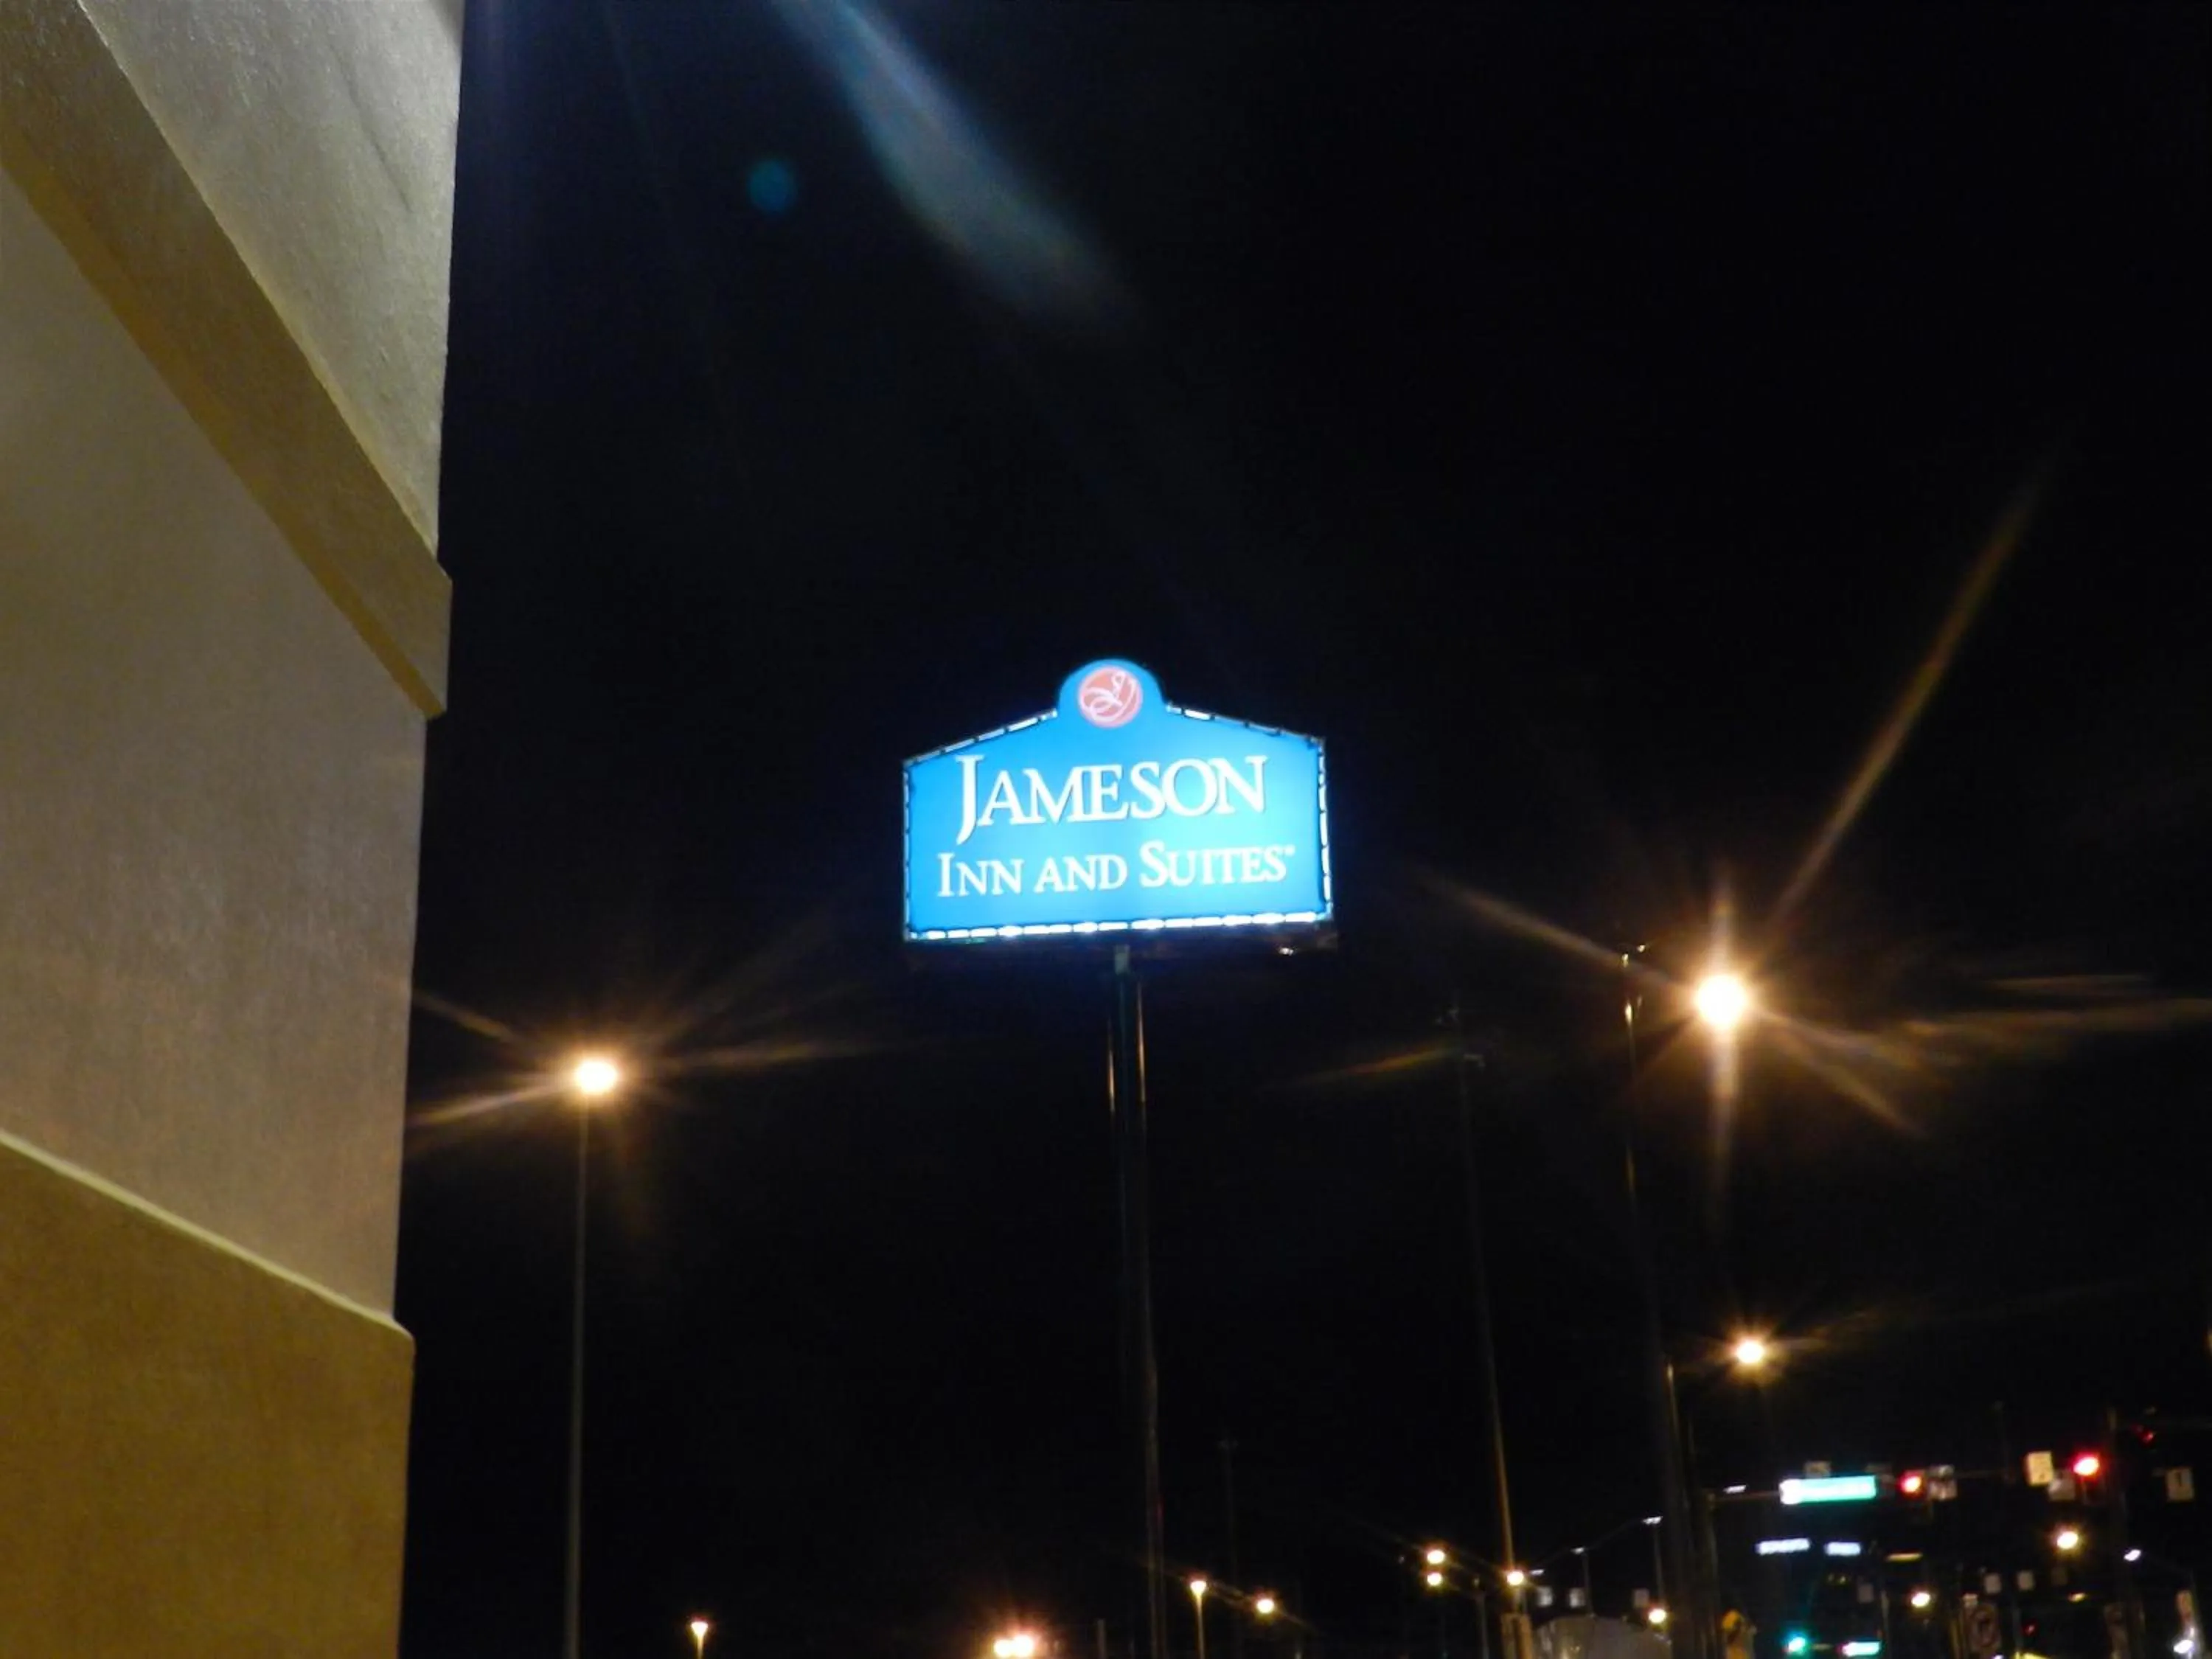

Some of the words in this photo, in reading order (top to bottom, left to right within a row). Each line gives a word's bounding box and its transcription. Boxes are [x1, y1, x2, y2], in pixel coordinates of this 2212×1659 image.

[956, 754, 1267, 845] JAMESON
[936, 852, 1024, 897] INN
[1034, 854, 1128, 893] AND
[1139, 841, 1290, 886] SUITES
